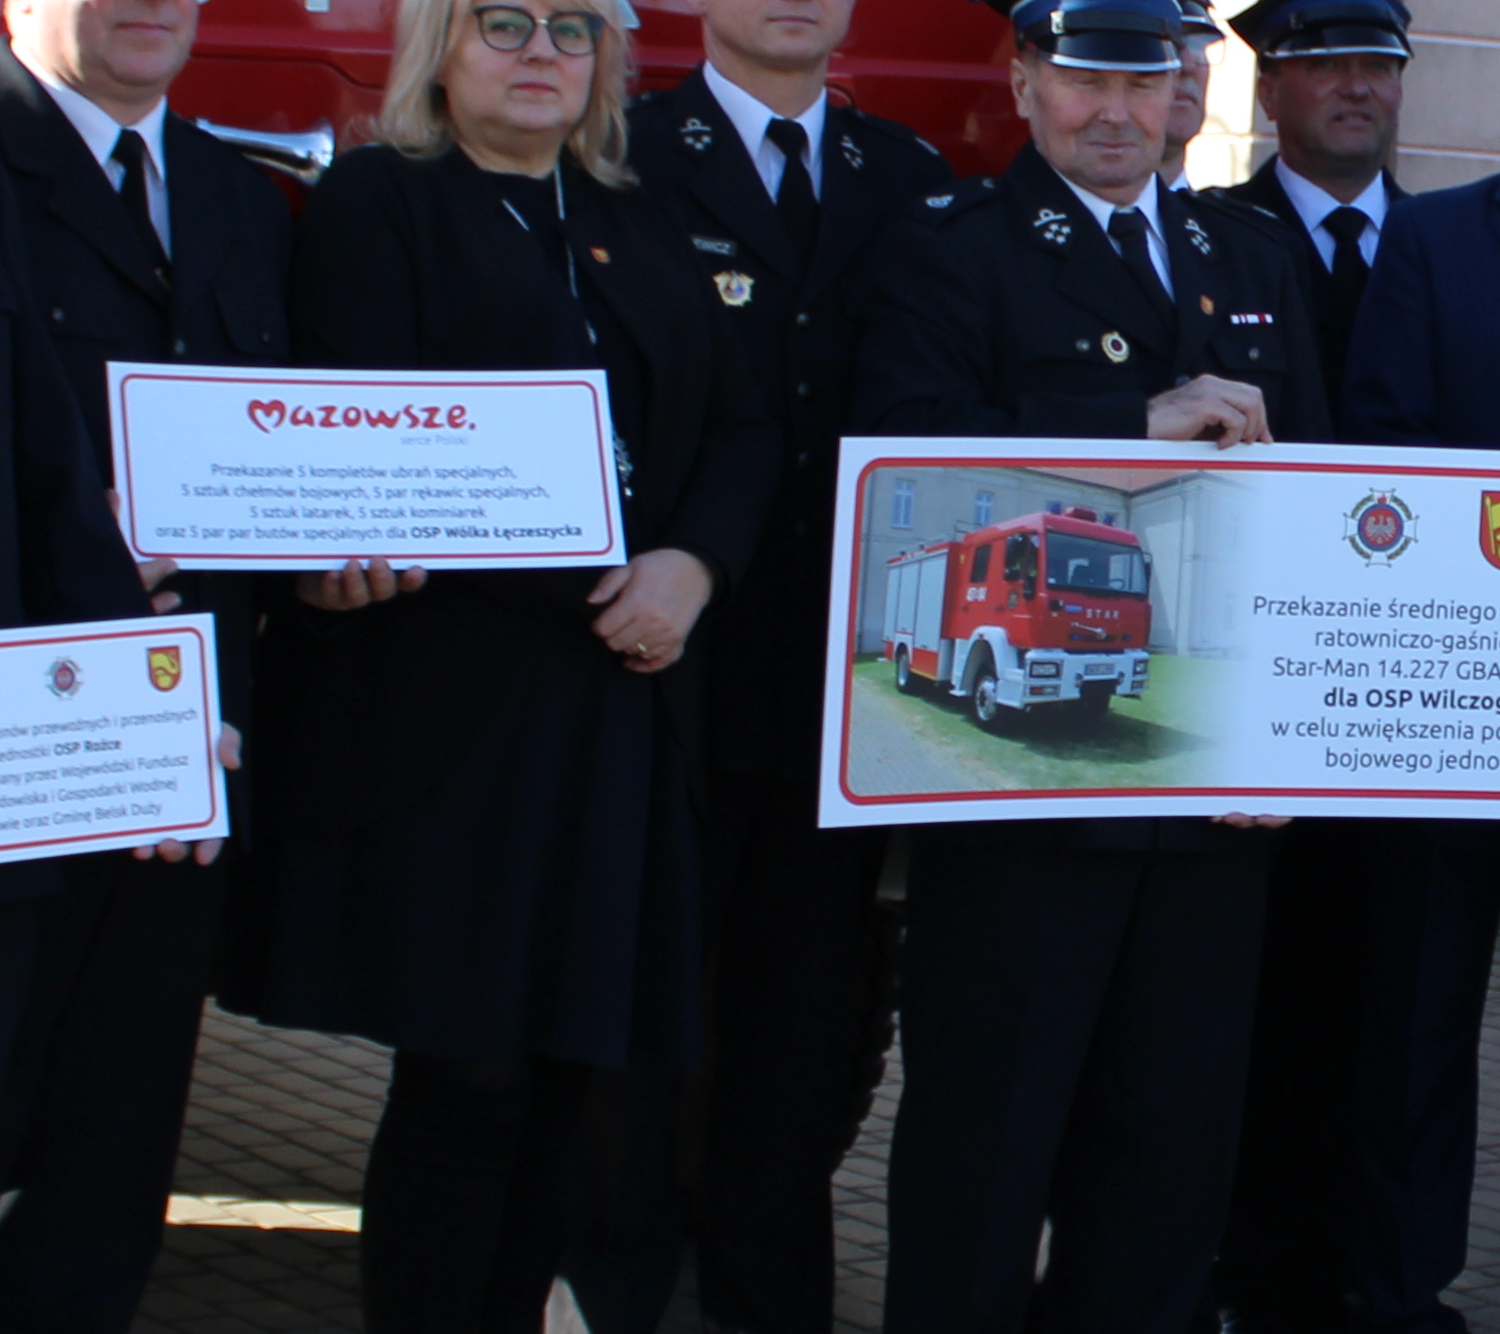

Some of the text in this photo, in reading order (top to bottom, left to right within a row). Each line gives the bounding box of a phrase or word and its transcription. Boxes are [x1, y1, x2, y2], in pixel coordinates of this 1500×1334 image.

[1253, 595, 1382, 618] Przekazanie
[1387, 597, 1497, 625] średniego
[1272, 656, 1370, 678] Star-Man
[1377, 659, 1450, 680] 14.227
[1323, 686, 1357, 707] dla
[1365, 689, 1414, 708] OSP
[1270, 721, 1290, 736] w
[1295, 716, 1339, 738] celu
[1345, 717, 1474, 743] zwiększenia
[1325, 746, 1433, 773] bojowego
